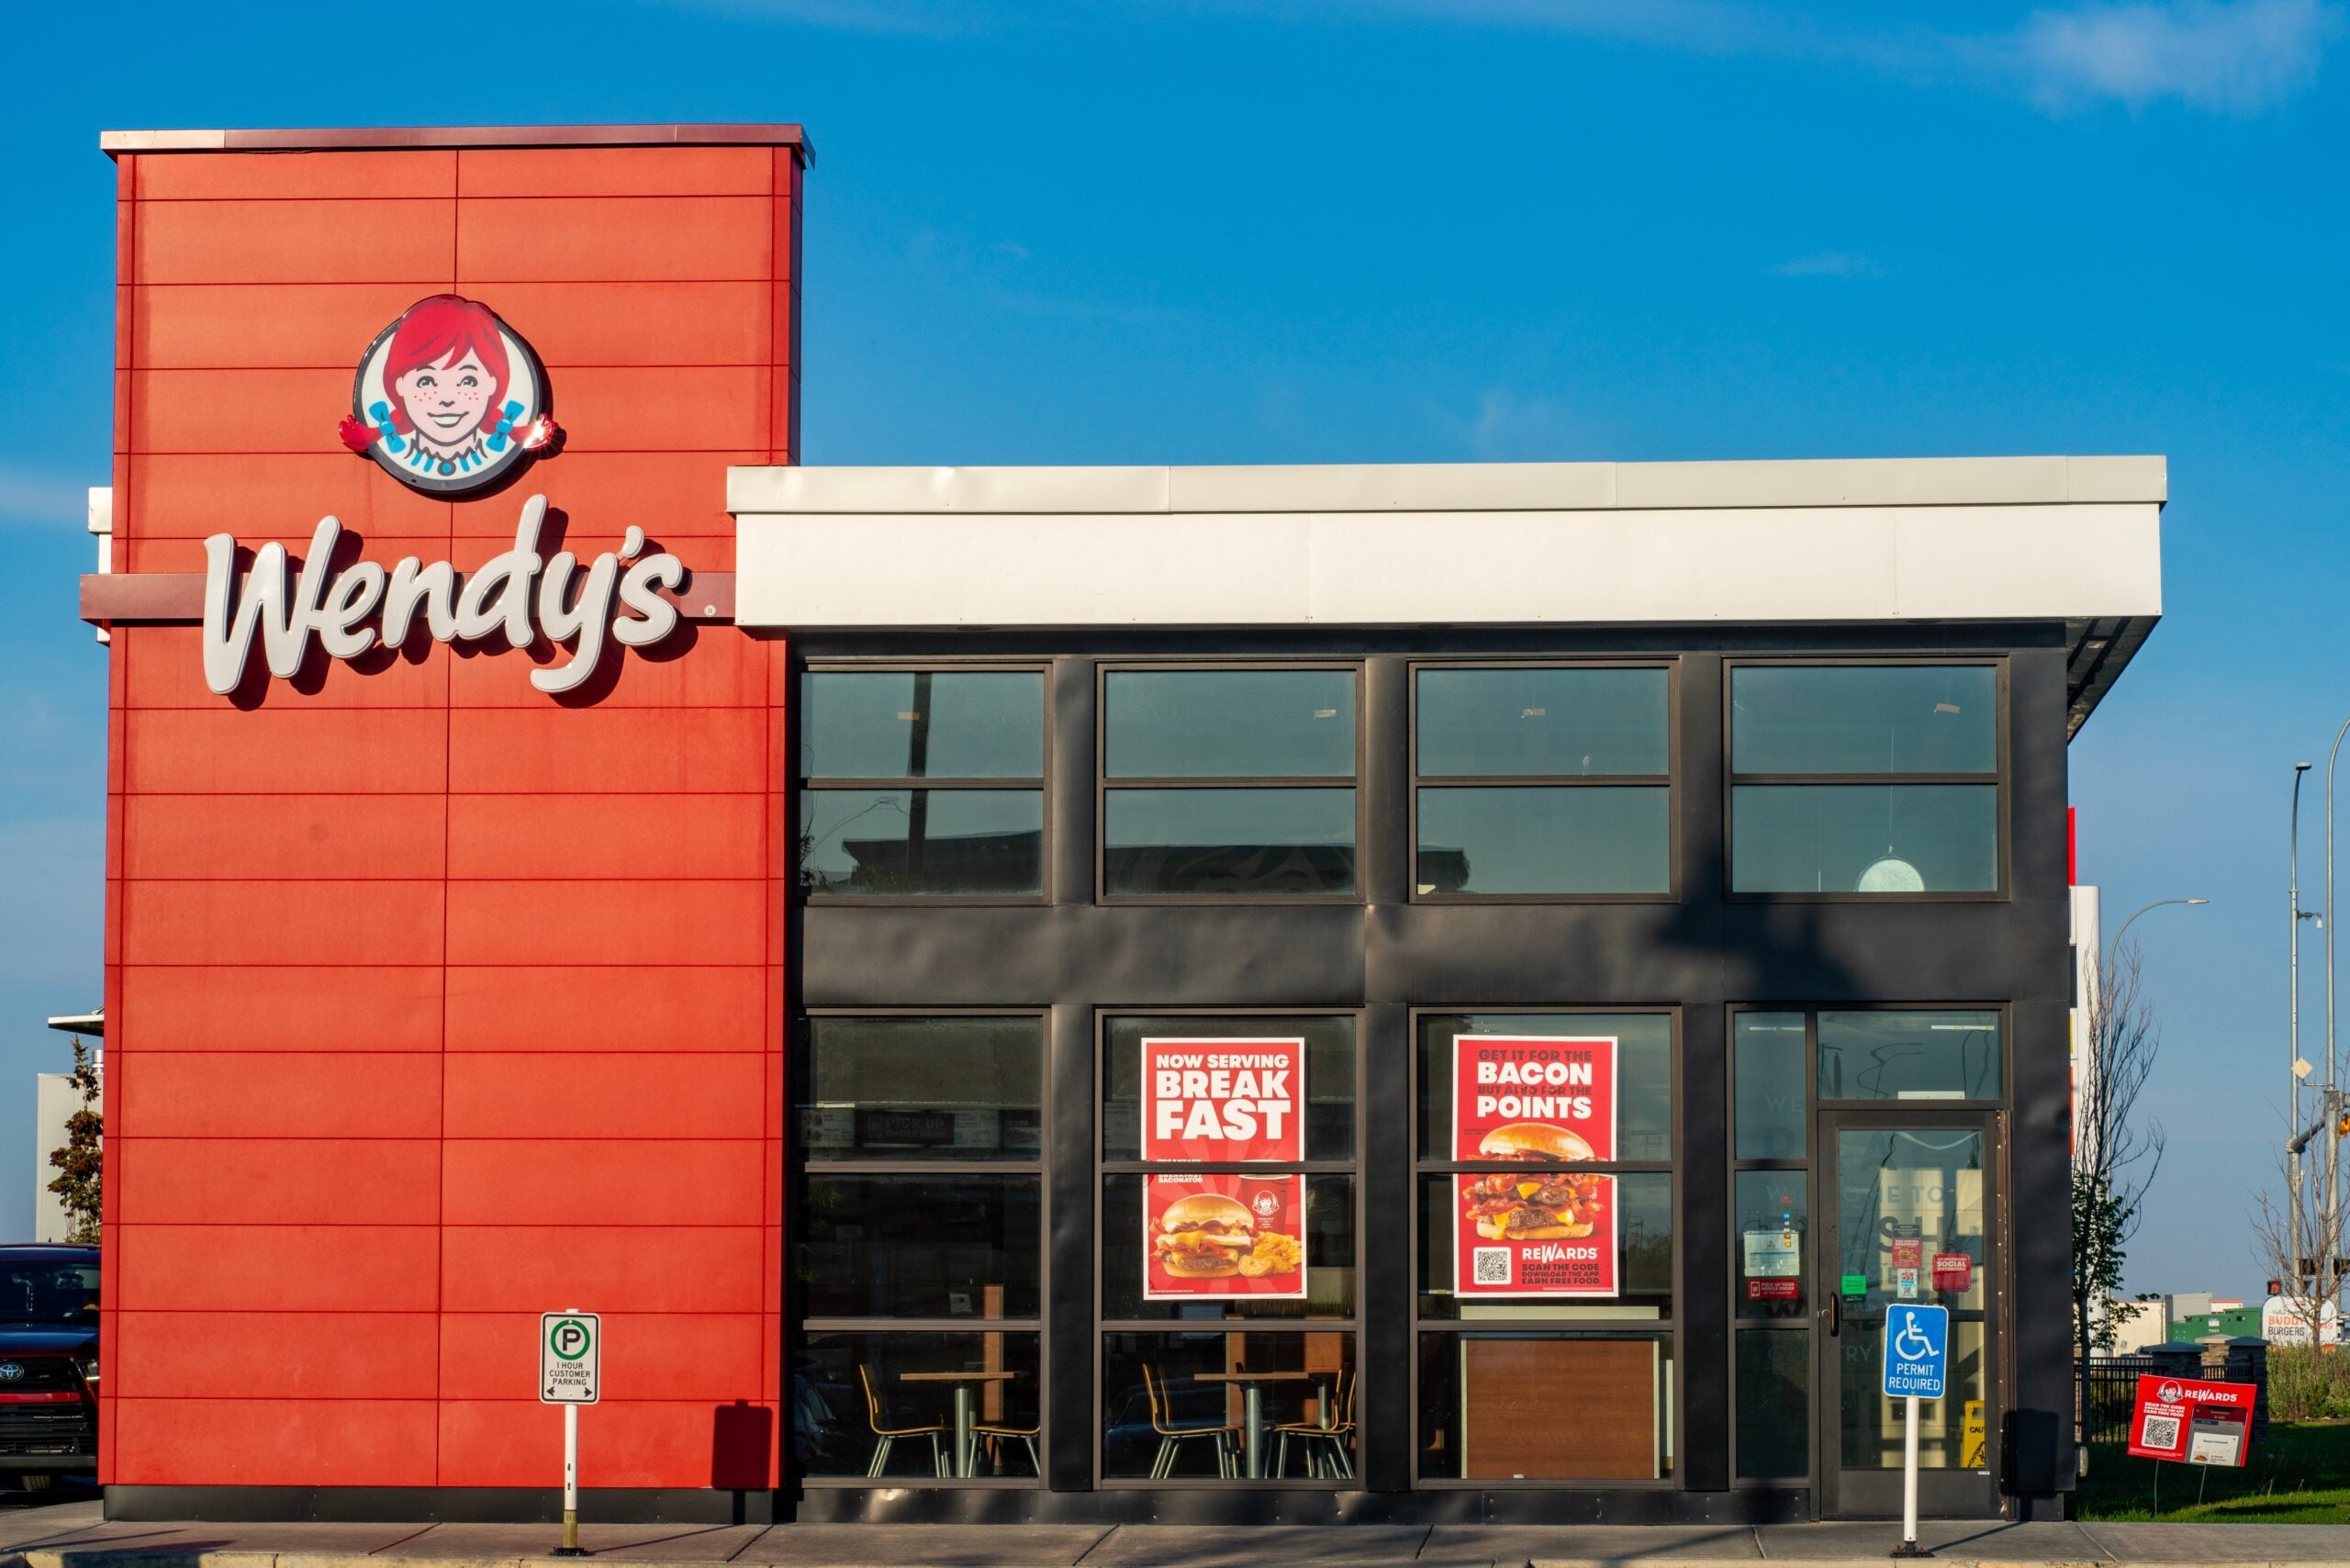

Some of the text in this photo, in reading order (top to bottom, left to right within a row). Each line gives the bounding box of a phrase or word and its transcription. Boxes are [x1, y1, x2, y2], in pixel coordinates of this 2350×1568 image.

[203, 494, 684, 695] Wendy's
[1157, 1055, 1289, 1069] NOW SERVING
[1479, 1049, 1593, 1061] GET IT FOR THE
[1477, 1062, 1593, 1085] BACON
[1157, 1070, 1291, 1099] BREAK
[1478, 1085, 1592, 1096] BUT ALSO FOR THE
[1477, 1095, 1593, 1119] POINTS
[1156, 1099, 1292, 1141] FAST
[1522, 1243, 1598, 1264] REWARDS
[2268, 1327, 2305, 1336] BURGERS
[1897, 1363, 1935, 1376] PERMIT
[1888, 1377, 1941, 1391] REQUIRED
[2185, 1389, 2238, 1402] REWARDS
